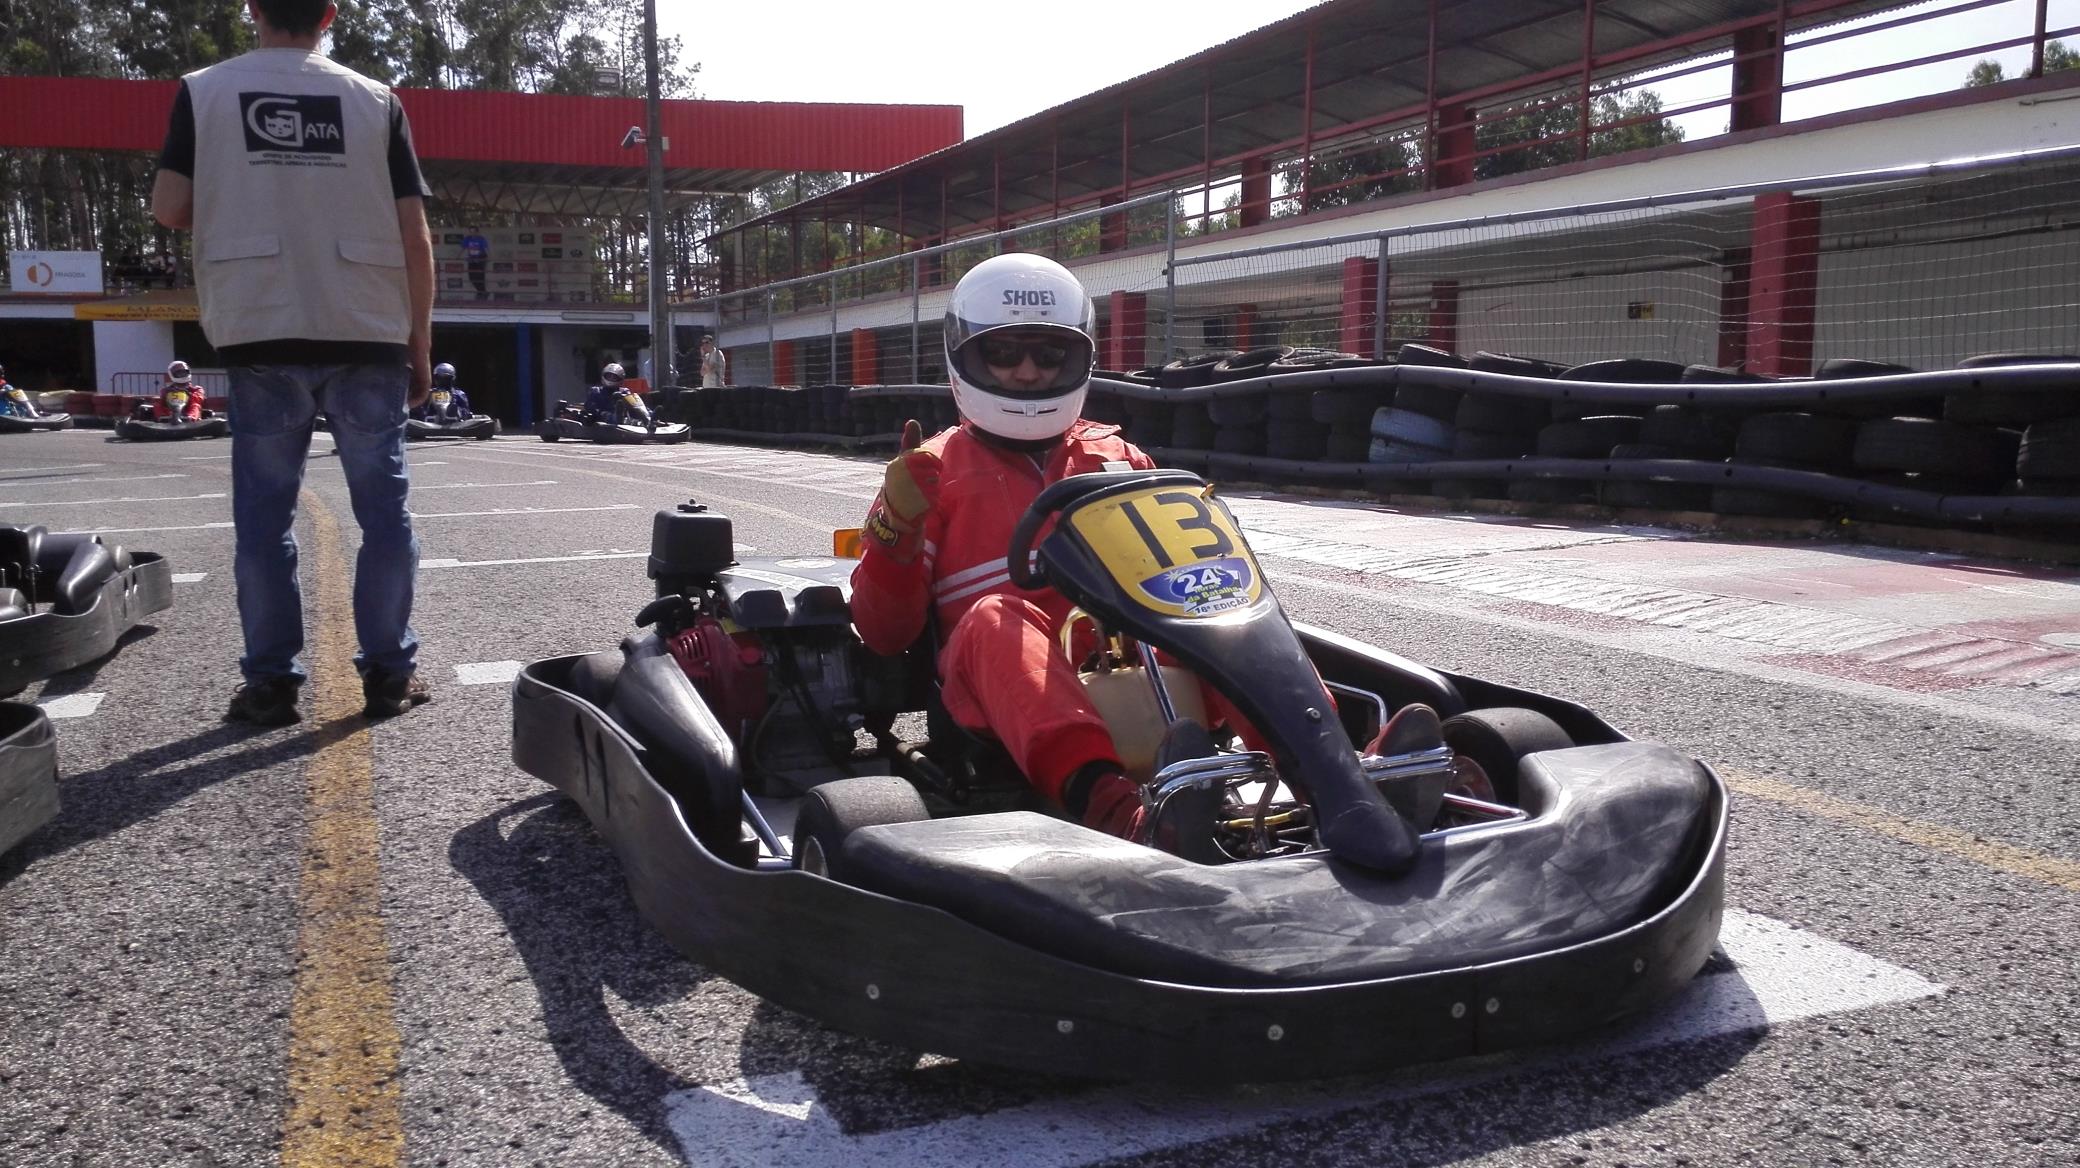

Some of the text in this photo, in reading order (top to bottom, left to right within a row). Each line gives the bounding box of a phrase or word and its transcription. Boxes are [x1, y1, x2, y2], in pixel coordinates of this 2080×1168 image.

[247, 97, 340, 147] GATA
[1002, 289, 1056, 306] SHOEI
[1119, 491, 1235, 569] 13
[1177, 568, 1221, 594] 24
[1201, 585, 1240, 598] Batalha
[1213, 597, 1250, 611] EDIÇÃO
